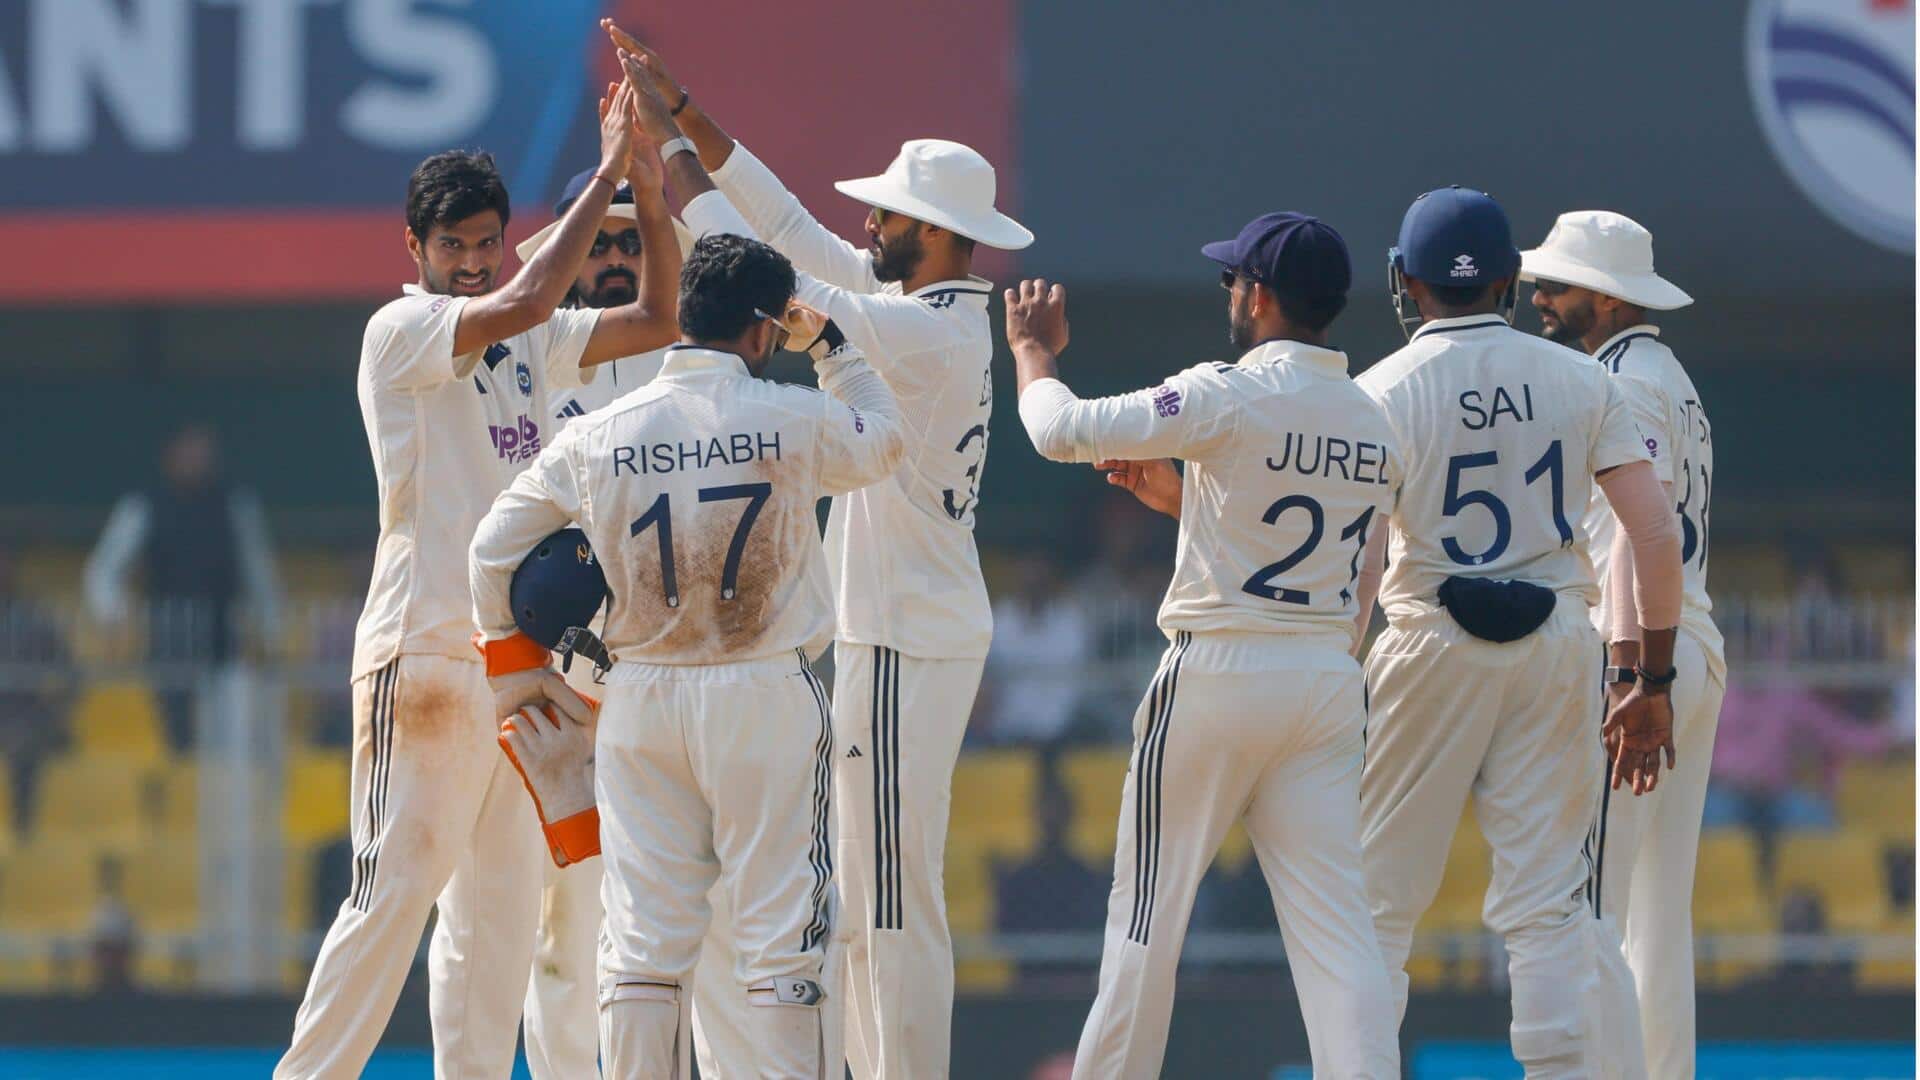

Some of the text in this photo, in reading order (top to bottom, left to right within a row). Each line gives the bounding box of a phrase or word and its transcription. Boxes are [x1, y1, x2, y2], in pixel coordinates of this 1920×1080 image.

[1459, 383, 1534, 431] SAI
[613, 431, 781, 477] RISHABH
[1266, 432, 1389, 485] JUREL
[1440, 439, 1574, 566] 51
[630, 482, 773, 608] 17
[1241, 494, 1377, 607] 21
